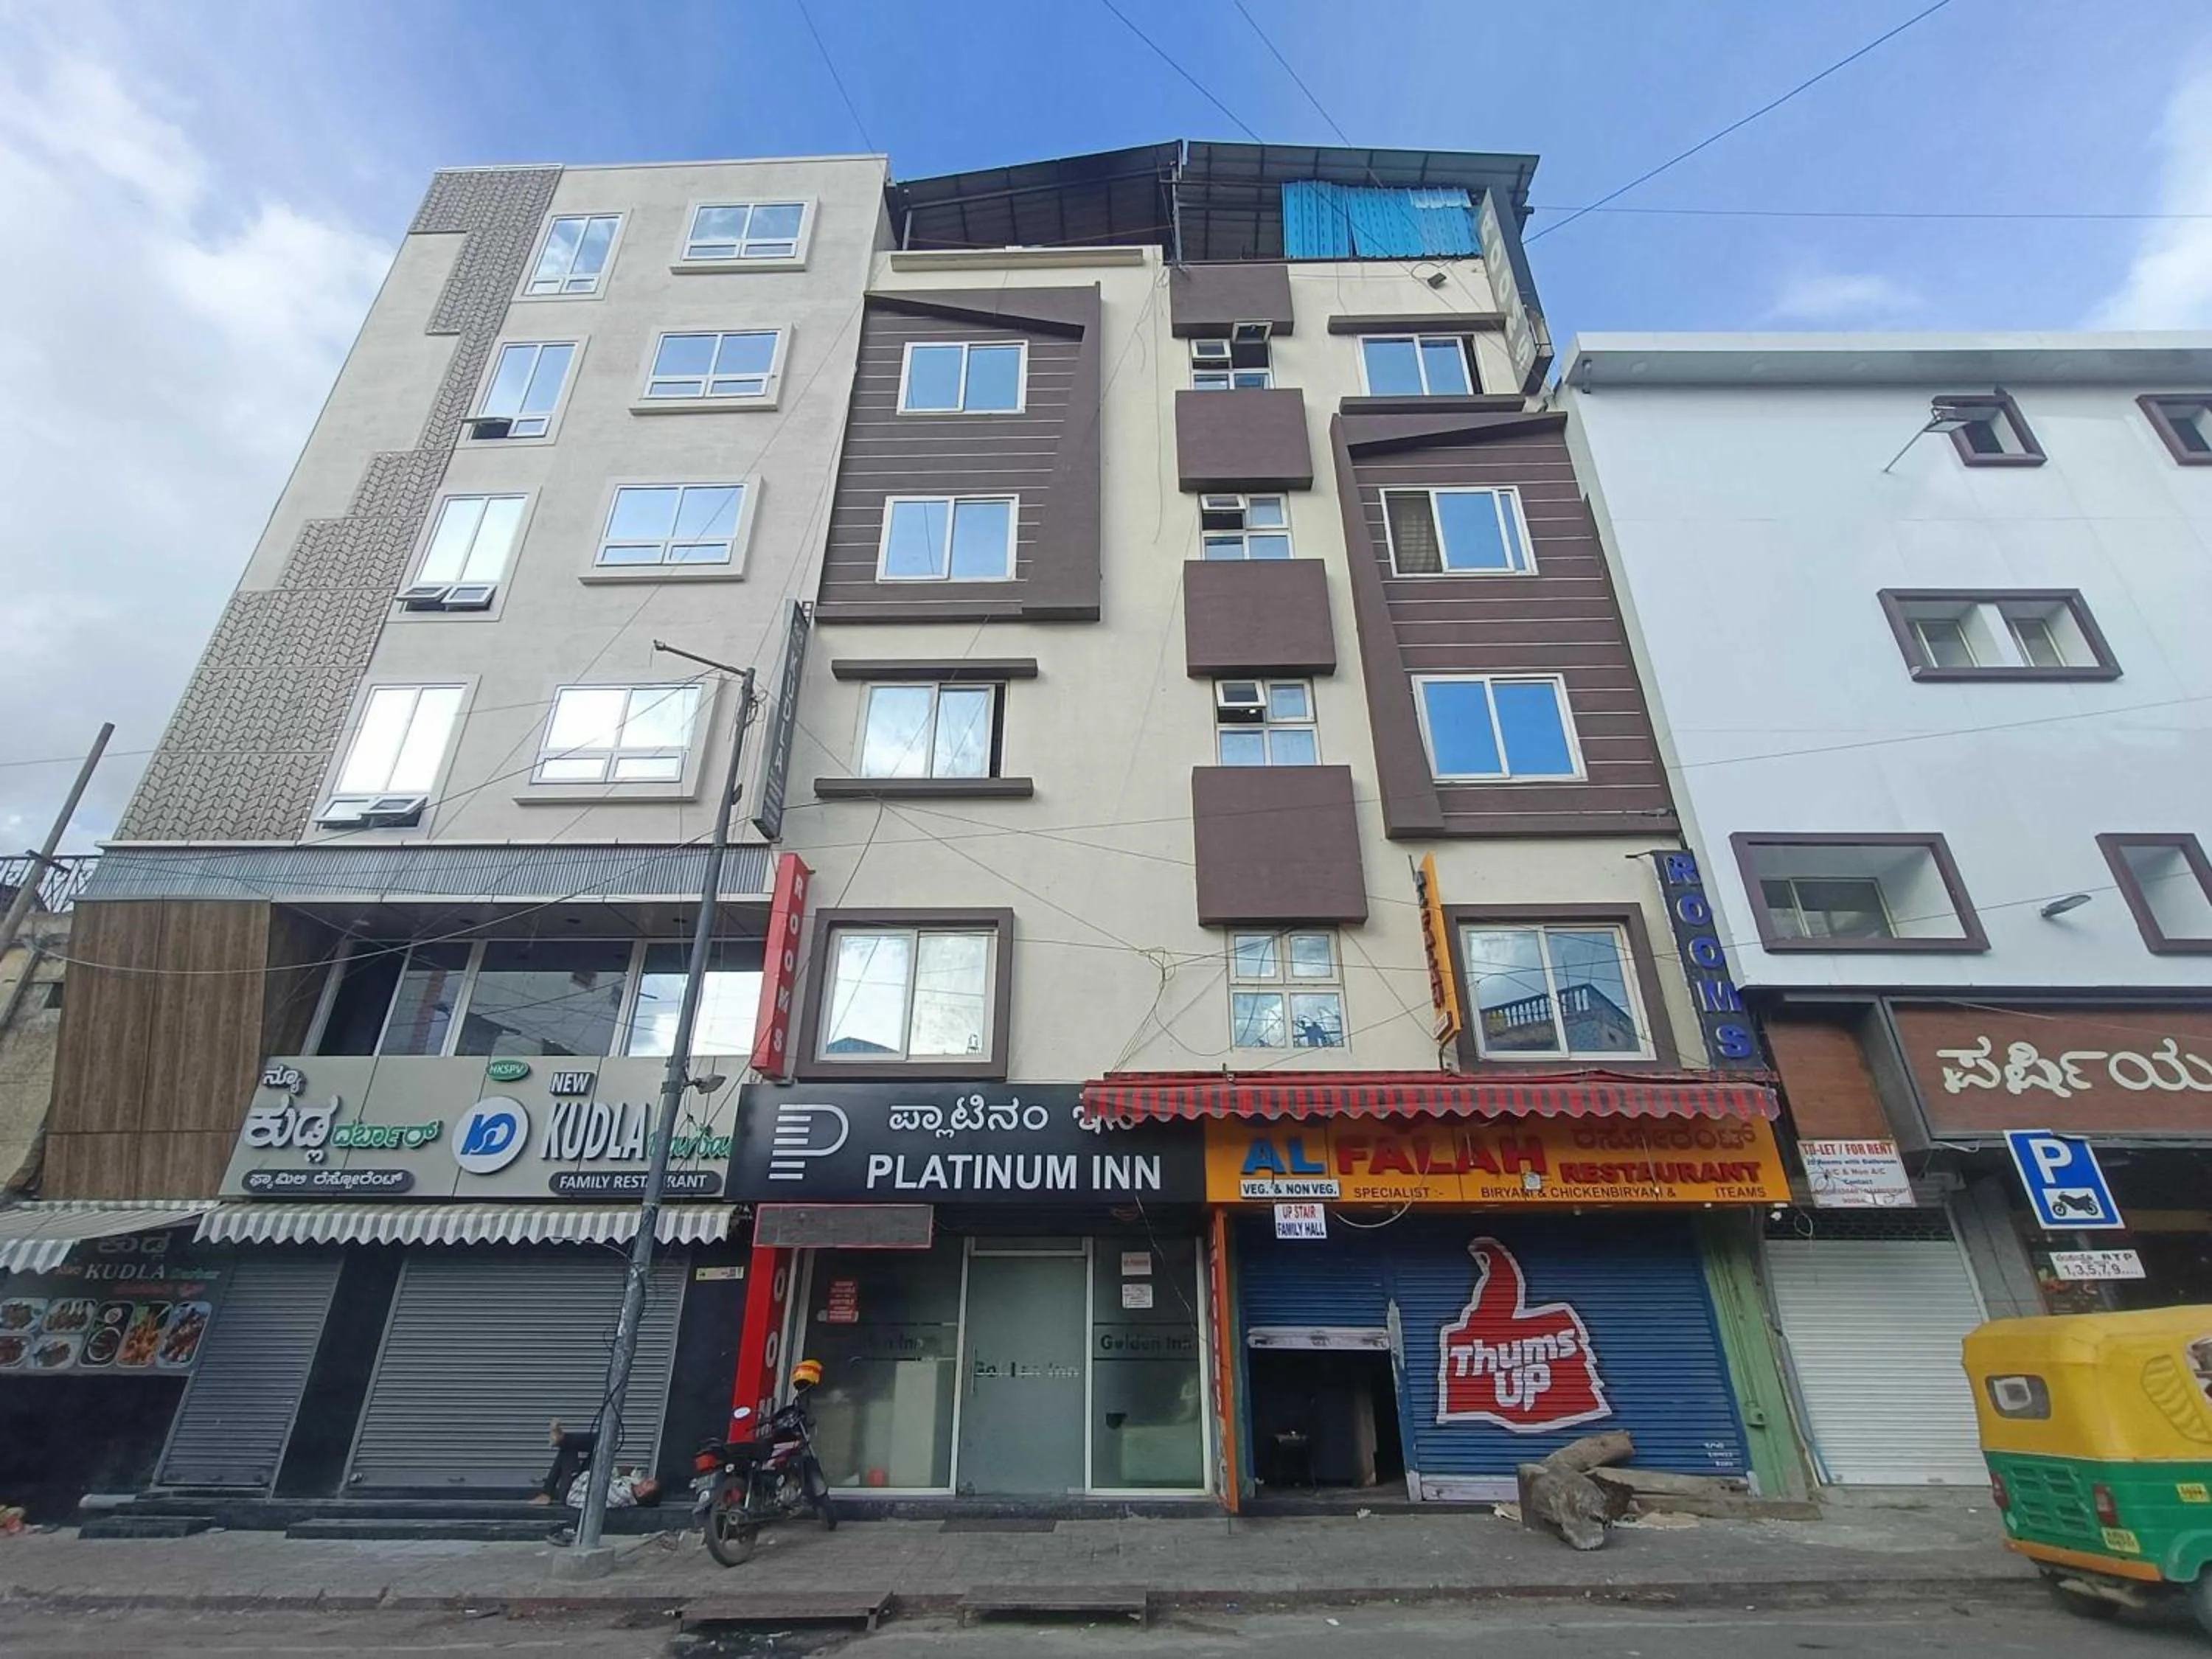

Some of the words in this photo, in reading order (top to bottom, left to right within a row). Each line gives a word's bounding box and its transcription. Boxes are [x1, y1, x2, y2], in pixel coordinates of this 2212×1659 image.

[772, 873, 804, 1053] ROOMS
[1666, 854, 1753, 1060] ROOMS
[550, 1072, 590, 1093] NEW
[540, 1102, 650, 1161] KUDLA
[1240, 1136, 1325, 1175] AL
[1335, 1135, 1548, 1175] FALAH
[1845, 1143, 1866, 1155] FOR
[1868, 1142, 1893, 1155] RENT
[2028, 1138, 2073, 1184] P
[559, 1175, 611, 1189] FAMILY
[614, 1174, 709, 1189] RESTRANT
[866, 1155, 1077, 1191] PLATINUM
[1091, 1155, 1162, 1191] INN
[1559, 1162, 1763, 1183] RESTAURANT
[1274, 1183, 1284, 1194] &
[1354, 1186, 1430, 1199] SPECIALIST
[1667, 1188, 1677, 1198] &
[1715, 1186, 1767, 1198] ITEAMS
[1282, 1205, 1293, 1219] UP
[1293, 1204, 1317, 1218] STAIR
[1276, 1222, 1303, 1237] FAMILY
[1304, 1222, 1326, 1237] HALL
[84, 1263, 166, 1280] KUDLA
[1450, 1328, 1577, 1377] Thums
